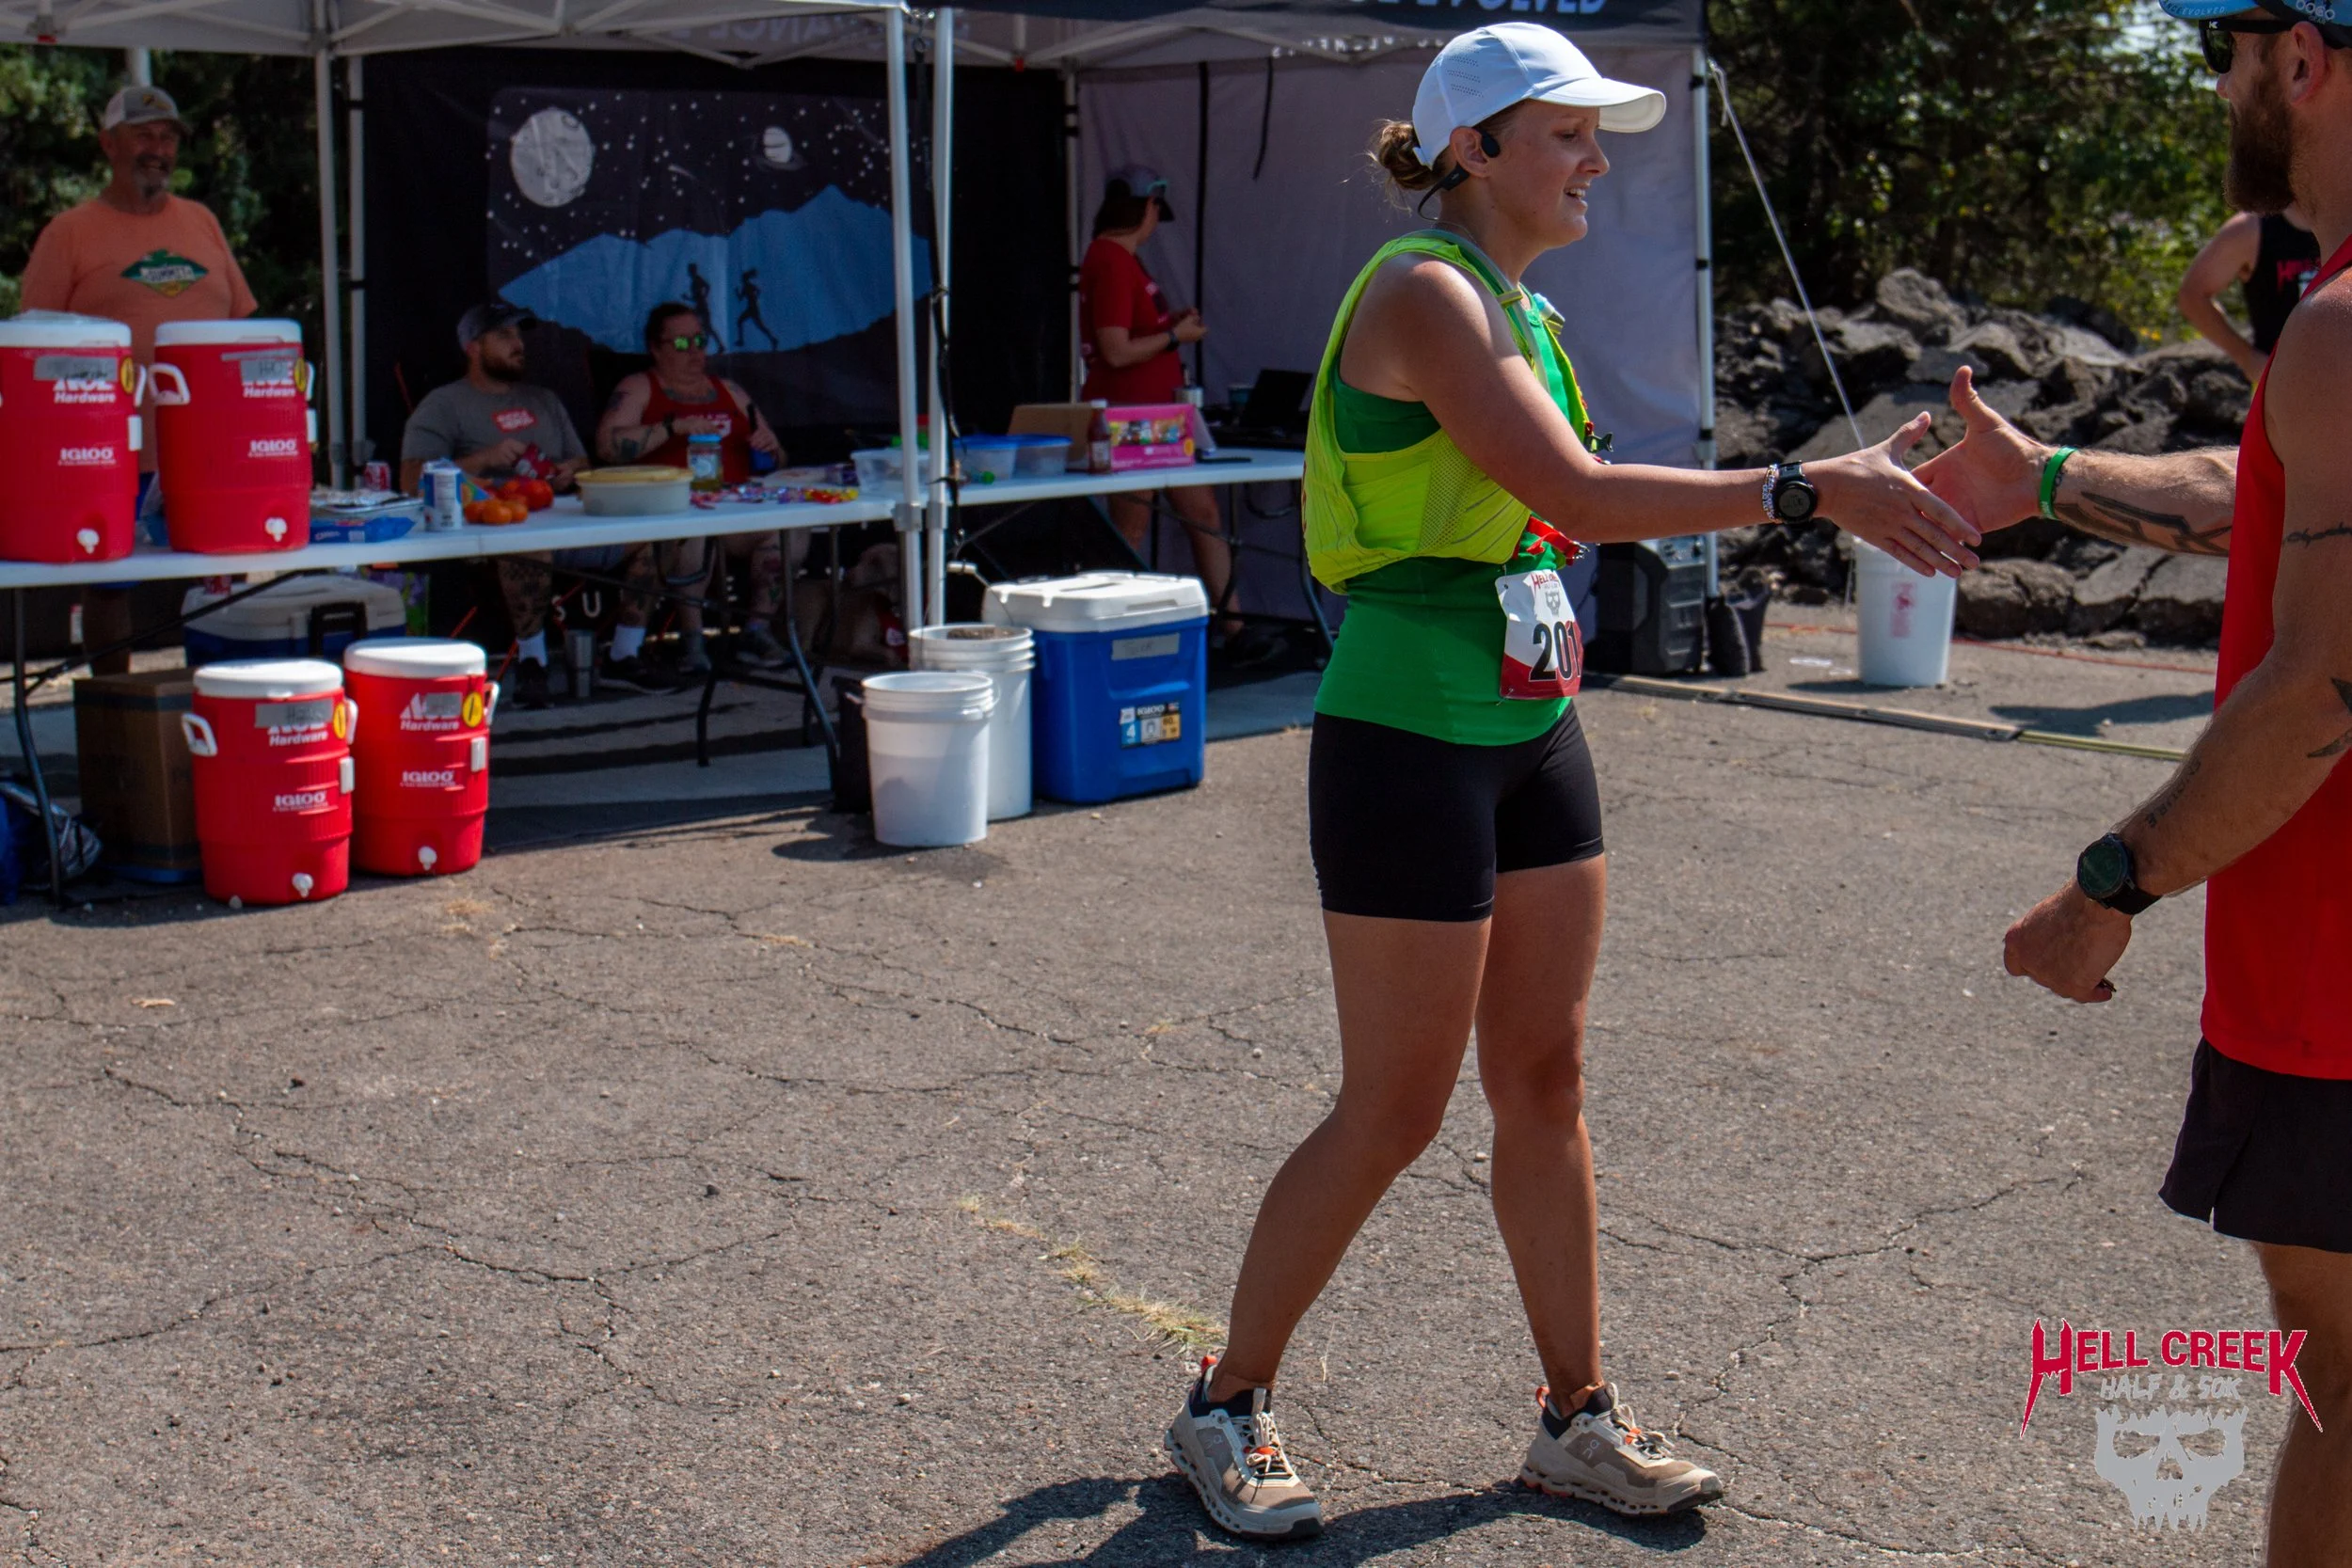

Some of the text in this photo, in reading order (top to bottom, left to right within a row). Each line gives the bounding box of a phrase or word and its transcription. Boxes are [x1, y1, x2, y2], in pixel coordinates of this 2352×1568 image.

[54, 391, 117, 404] Hardware
[243, 387, 296, 398] Hardware
[248, 439, 297, 452] IGLOO
[59, 447, 114, 460] IGLOO
[400, 720, 460, 732] Hardware
[269, 731, 328, 747] Hardware
[401, 770, 455, 784] IGLOO
[275, 791, 326, 807] IGLOO
